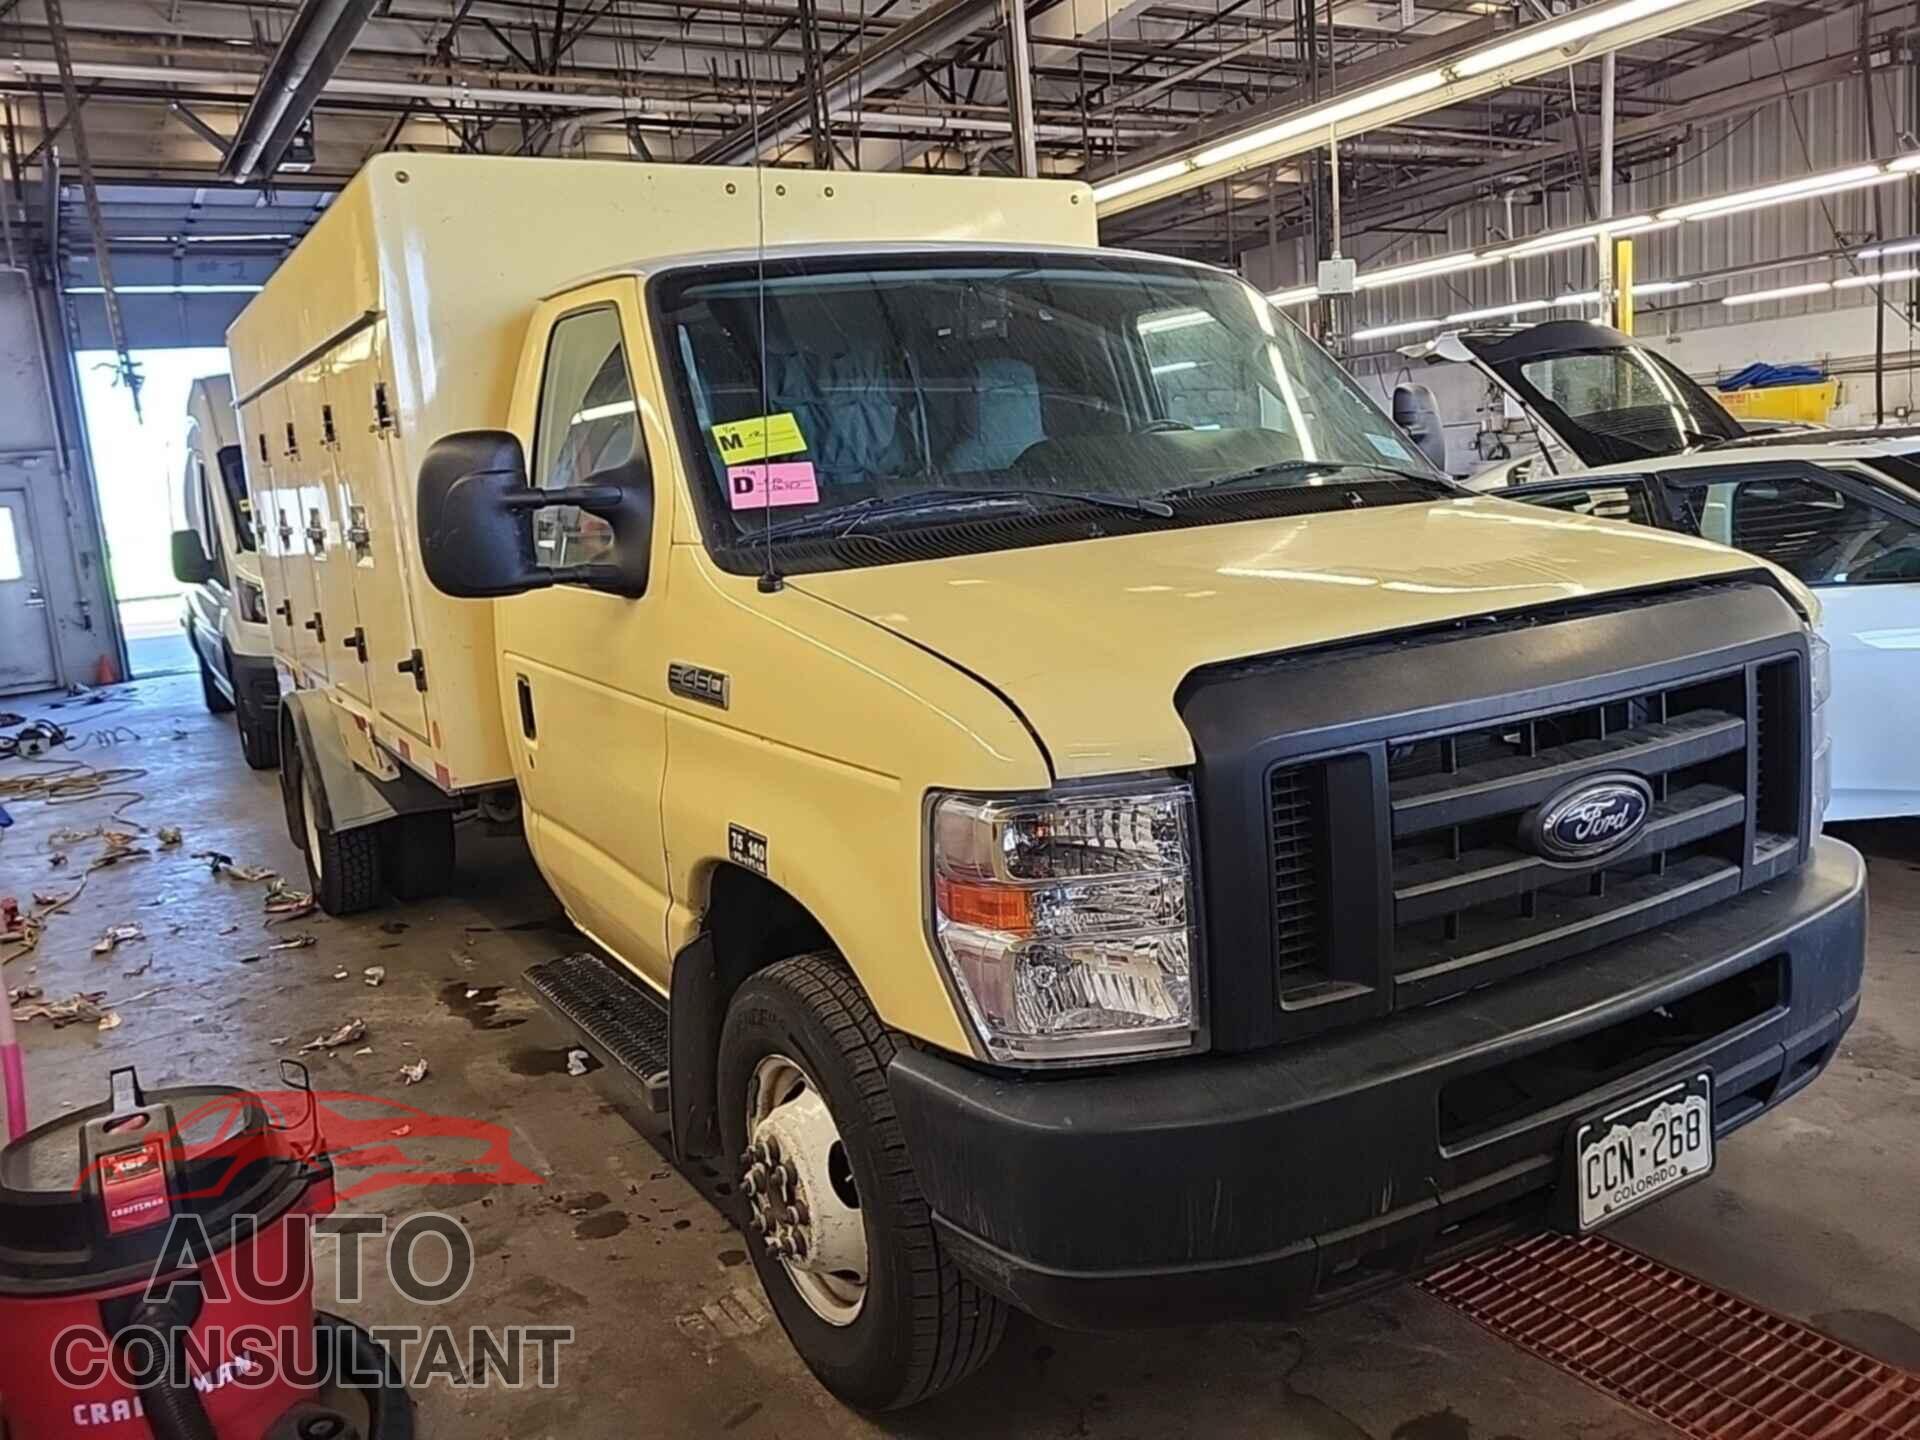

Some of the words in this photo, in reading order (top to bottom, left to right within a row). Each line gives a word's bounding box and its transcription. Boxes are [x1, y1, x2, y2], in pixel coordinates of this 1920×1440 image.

[719, 434, 743, 451] M
[734, 478, 754, 494] D
[1564, 799, 1630, 840] Ford
[1613, 1164, 1678, 1203] COLORADO
